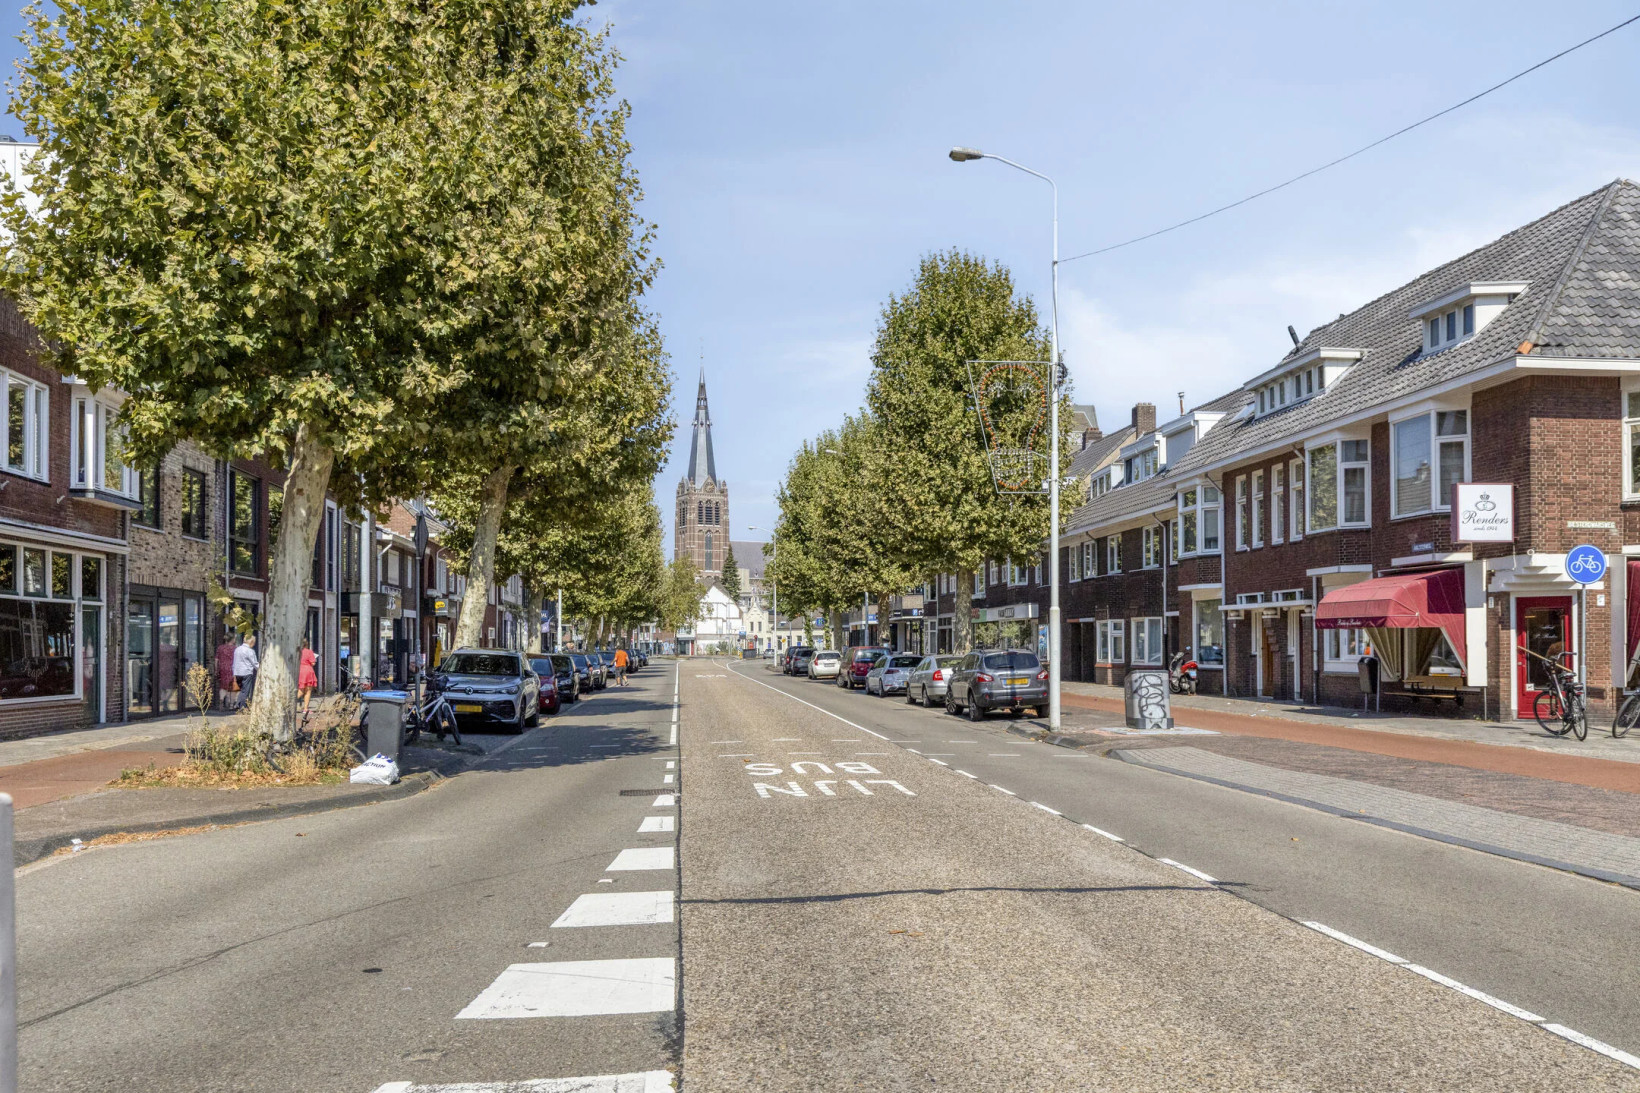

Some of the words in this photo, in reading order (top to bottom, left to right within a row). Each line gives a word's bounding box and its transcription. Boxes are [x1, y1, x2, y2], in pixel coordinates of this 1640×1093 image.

[1462, 510, 1509, 524] Renders
[744, 761, 882, 776] BUS
[752, 779, 917, 798] LIJN
